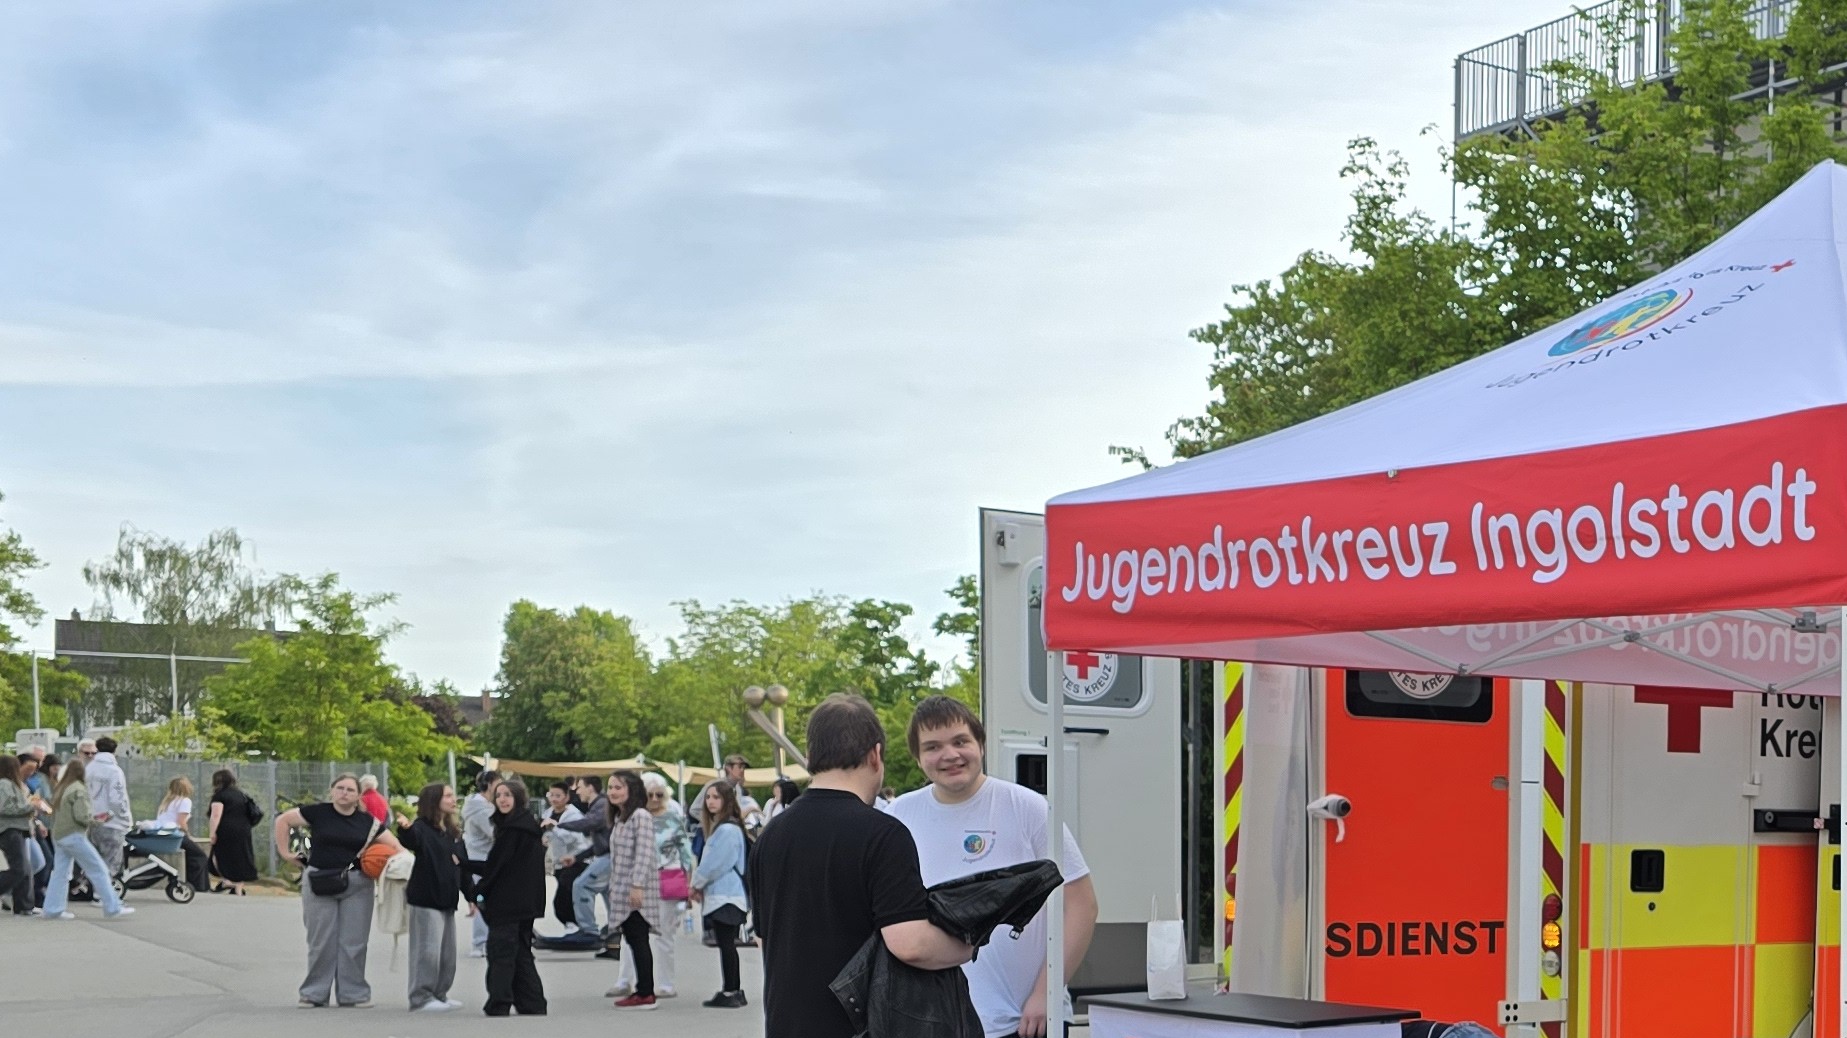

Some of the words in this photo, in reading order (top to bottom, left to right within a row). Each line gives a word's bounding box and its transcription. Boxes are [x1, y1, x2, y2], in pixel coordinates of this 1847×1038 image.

[1062, 515, 1457, 614] Jugendrotkreuz
[1471, 461, 1817, 584] Ingolstadt
[1084, 664, 1112, 695] KREUZ
[1760, 718, 1822, 759] Kre
[1325, 920, 1505, 957] SDIENST
